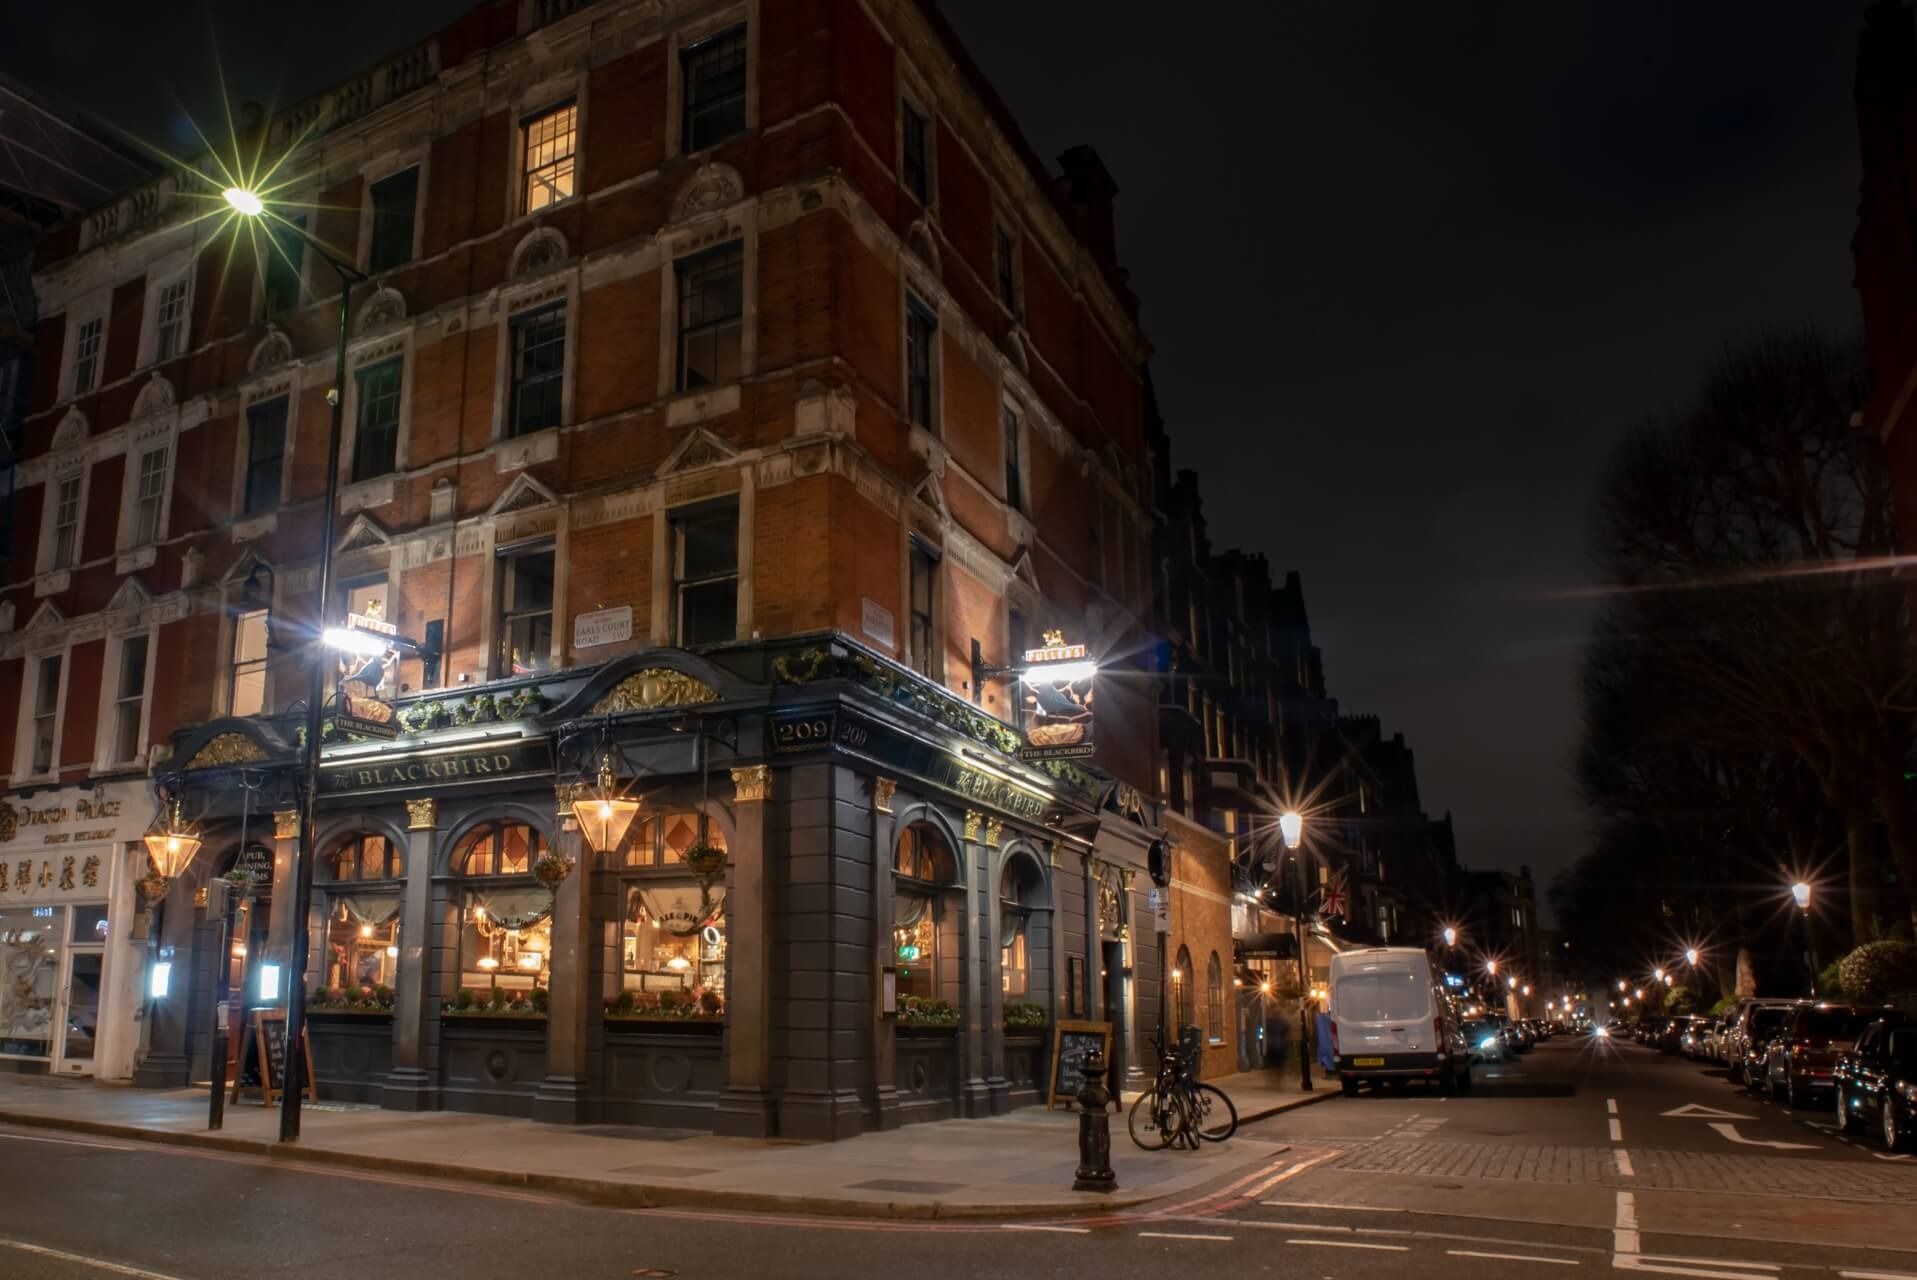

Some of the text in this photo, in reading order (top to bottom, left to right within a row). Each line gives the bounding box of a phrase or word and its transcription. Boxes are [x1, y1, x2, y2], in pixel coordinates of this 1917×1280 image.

[602, 619, 630, 633] COURT
[576, 633, 600, 646] ROAD
[780, 720, 828, 740] 209
[1024, 747, 1091, 758] THE BLACKBIRD
[334, 753, 512, 790] The BLACKBIRD
[971, 773, 1043, 816] BLACKBIRD
